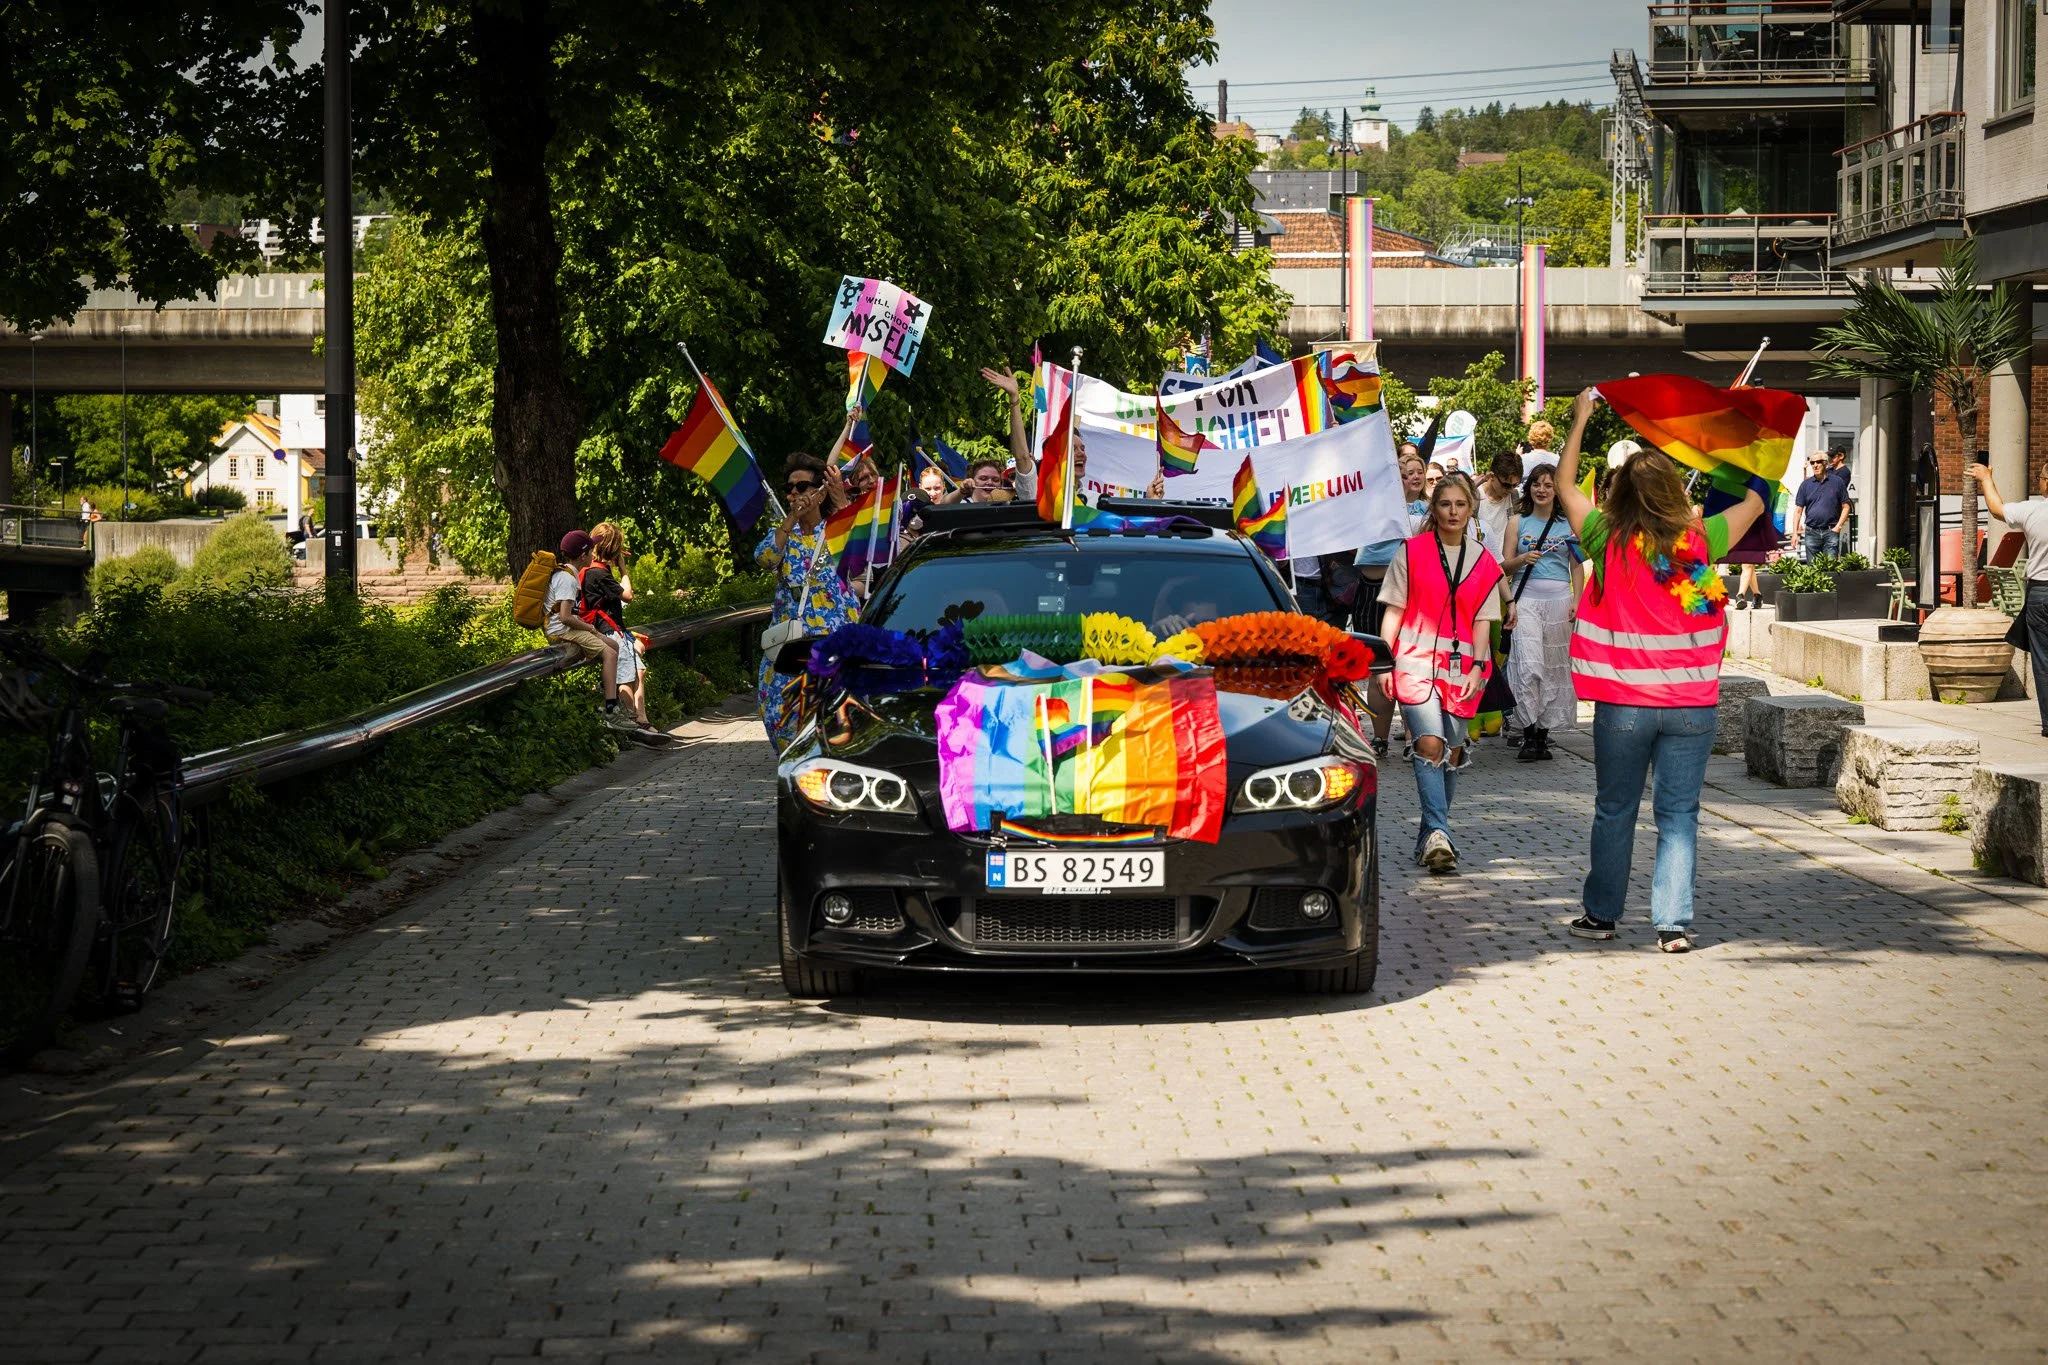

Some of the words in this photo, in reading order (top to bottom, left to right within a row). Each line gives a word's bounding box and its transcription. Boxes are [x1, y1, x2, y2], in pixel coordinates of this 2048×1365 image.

[865, 295, 890, 309] WILL
[884, 311, 919, 338] CHOOSE
[841, 311, 920, 367] MYSELF
[992, 872, 1001, 882] N
[1013, 857, 1048, 883] BS
[1062, 857, 1154, 883] 82549
